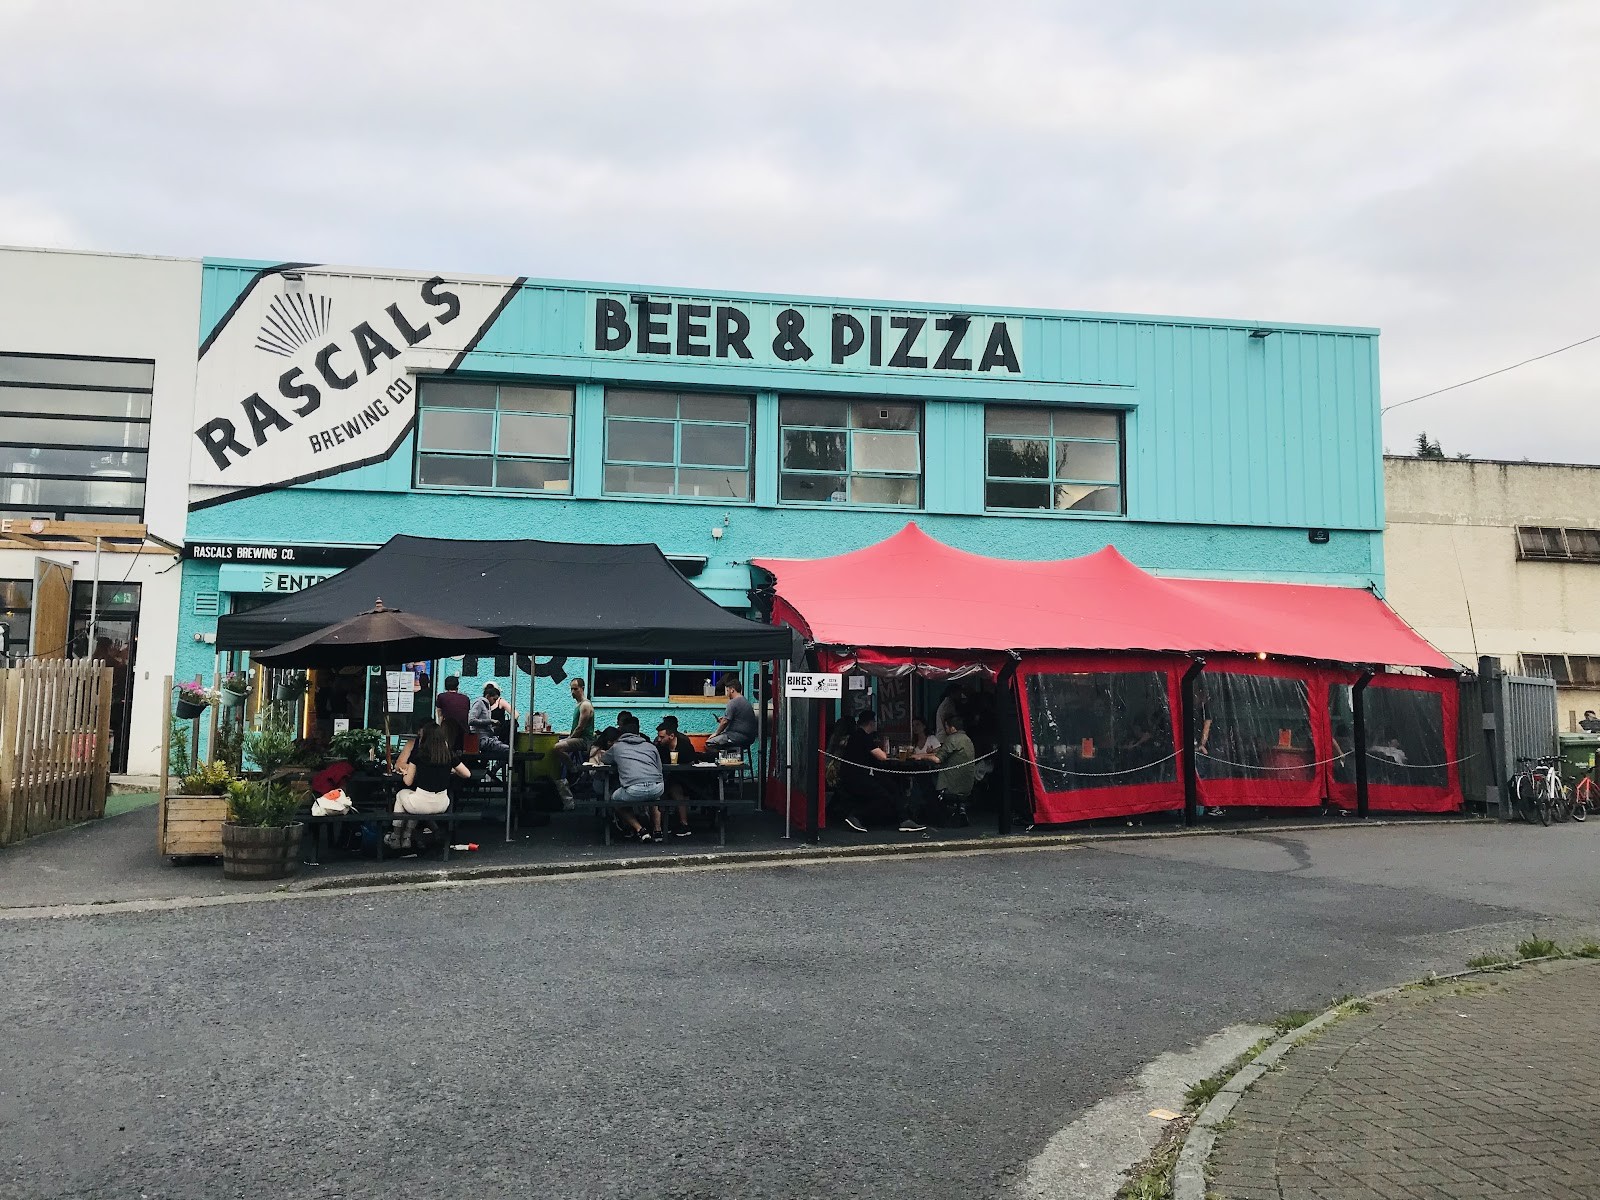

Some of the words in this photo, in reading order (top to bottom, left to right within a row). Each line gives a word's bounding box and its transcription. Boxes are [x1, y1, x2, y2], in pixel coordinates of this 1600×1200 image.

[595, 298, 754, 359] BEER
[772, 308, 814, 362] &
[831, 313, 1021, 373] PIZZA
[194, 276, 461, 471] RASCALS
[309, 398, 389, 454] BREWING
[385, 377, 412, 405] CO
[193, 546, 232, 558] RASCALS
[236, 547, 277, 559] BREWING
[281, 548, 295, 560] CO.
[787, 676, 812, 686] BIKES
